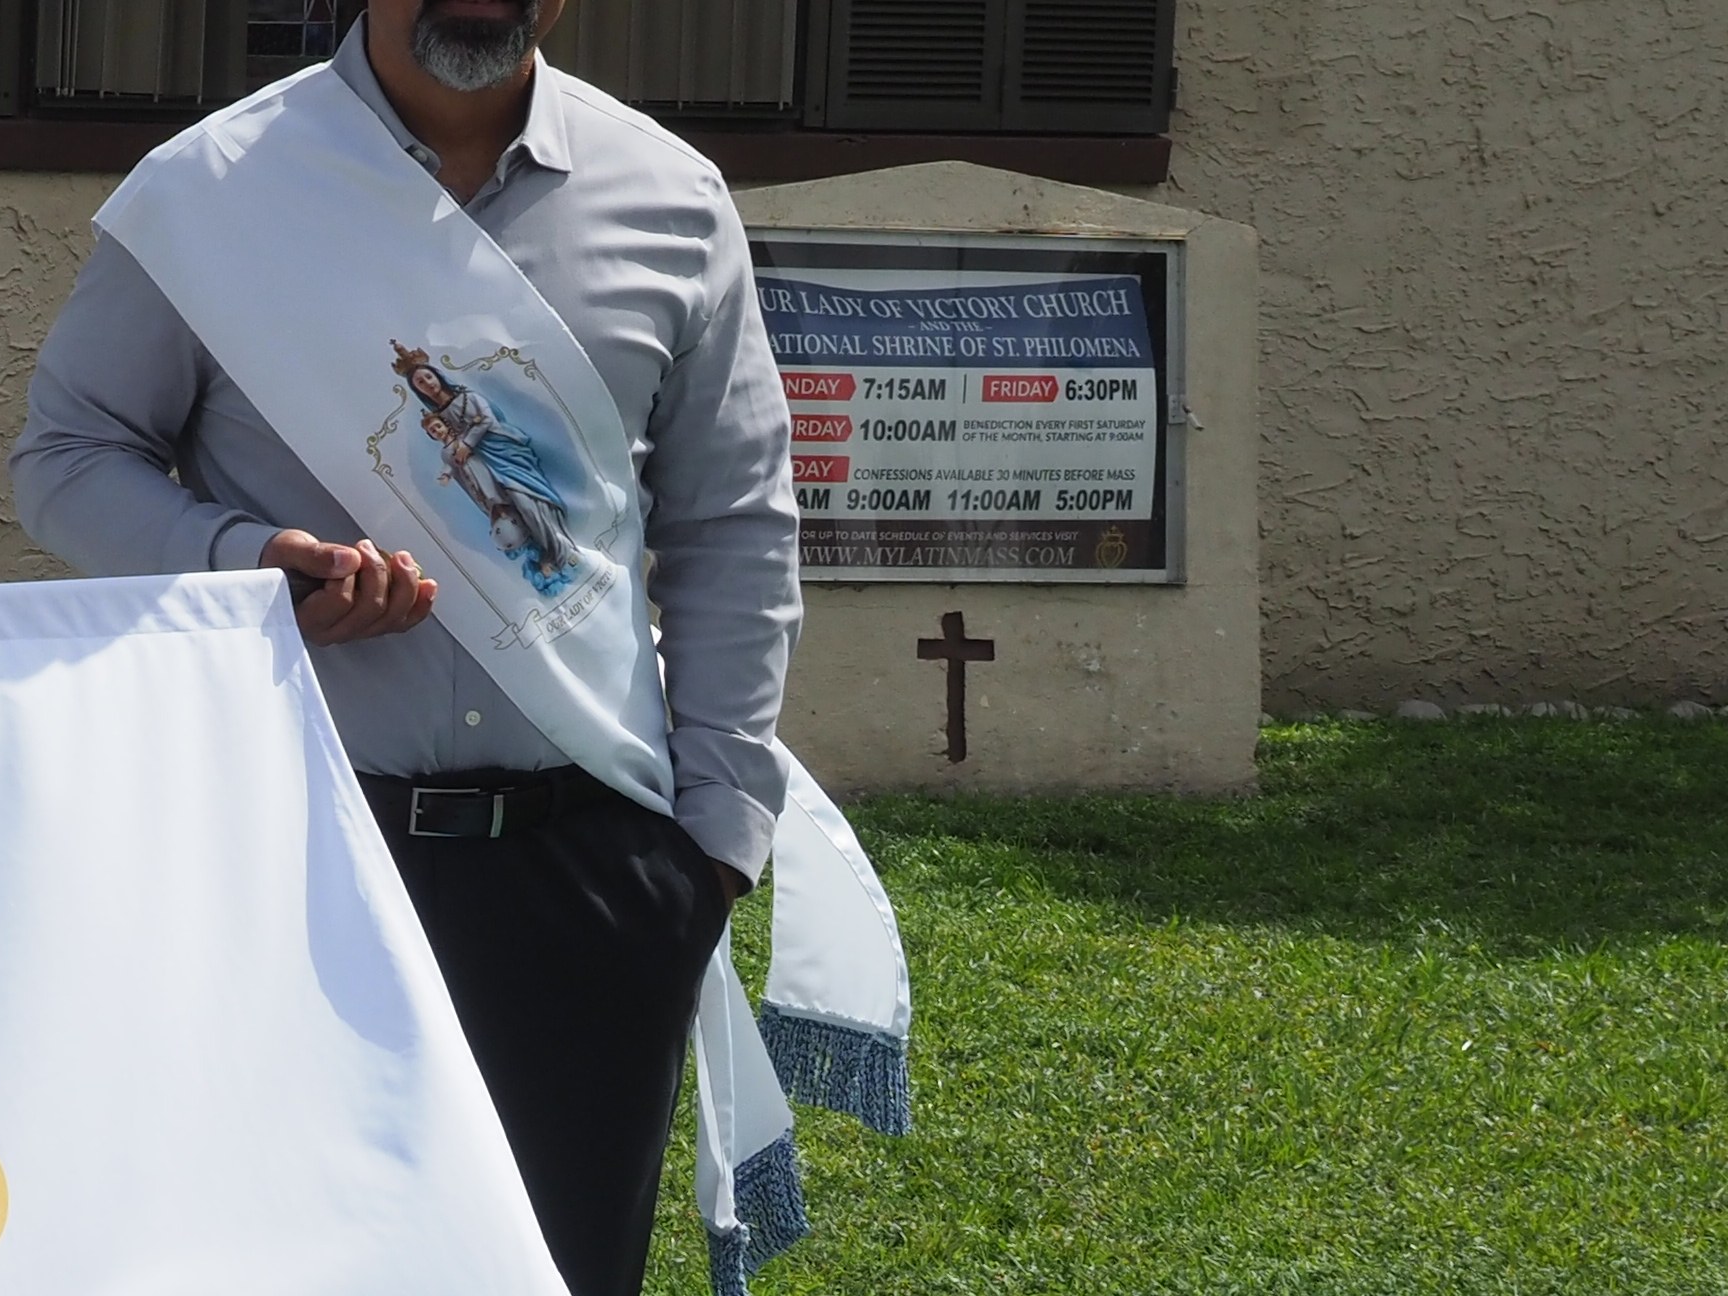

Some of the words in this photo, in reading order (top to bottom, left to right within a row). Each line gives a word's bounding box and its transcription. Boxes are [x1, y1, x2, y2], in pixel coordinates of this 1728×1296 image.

[757, 287, 797, 313] UR
[800, 290, 868, 318] LADY
[870, 298, 903, 319] OF
[905, 296, 1020, 320] VICTORY
[1023, 288, 1132, 318] CHURCH
[920, 321, 951, 332] AND
[951, 321, 984, 333] THE
[768, 333, 868, 356] ATIONAL
[872, 334, 956, 357] SHRINE
[960, 335, 987, 358] OF
[994, 336, 1020, 358] ST.
[1022, 336, 1141, 358] PHILOMENA
[784, 378, 841, 395] NDAY
[863, 377, 947, 401] 7:15AM
[990, 380, 1054, 397] FRIDAY
[1065, 378, 1138, 401] 6:30PM
[859, 418, 957, 442] 10:00AM
[963, 419, 1033, 430] BENEDICTION
[1035, 419, 1067, 431] EVERY
[1068, 420, 1095, 430] FIRST
[1096, 419, 1146, 430] SATURDAY
[962, 432, 982, 442] OF
[984, 432, 998, 442] THE
[1001, 432, 1044, 443] MONTH,
[1045, 432, 1093, 442] STARTING
[1095, 432, 1107, 442] AT
[853, 467, 933, 481] CONFESSIONS
[934, 468, 994, 481] AVAILABLE
[996, 469, 1011, 481] 30
[1012, 469, 1062, 481] MINUTES
[1063, 469, 1105, 481] BEFORE
[1106, 469, 1136, 481] MASS
[846, 488, 932, 512] 9:00AM
[947, 488, 1042, 512] 11:00AM
[1055, 488, 1134, 512] 5:00PM
[835, 530, 850, 540] TO
[850, 530, 877, 541] DATE
[878, 530, 931, 541] SCHEDULE
[947, 531, 984, 542] EVENTS
[565, 599, 585, 620] LADY
[583, 588, 595, 605] OF
